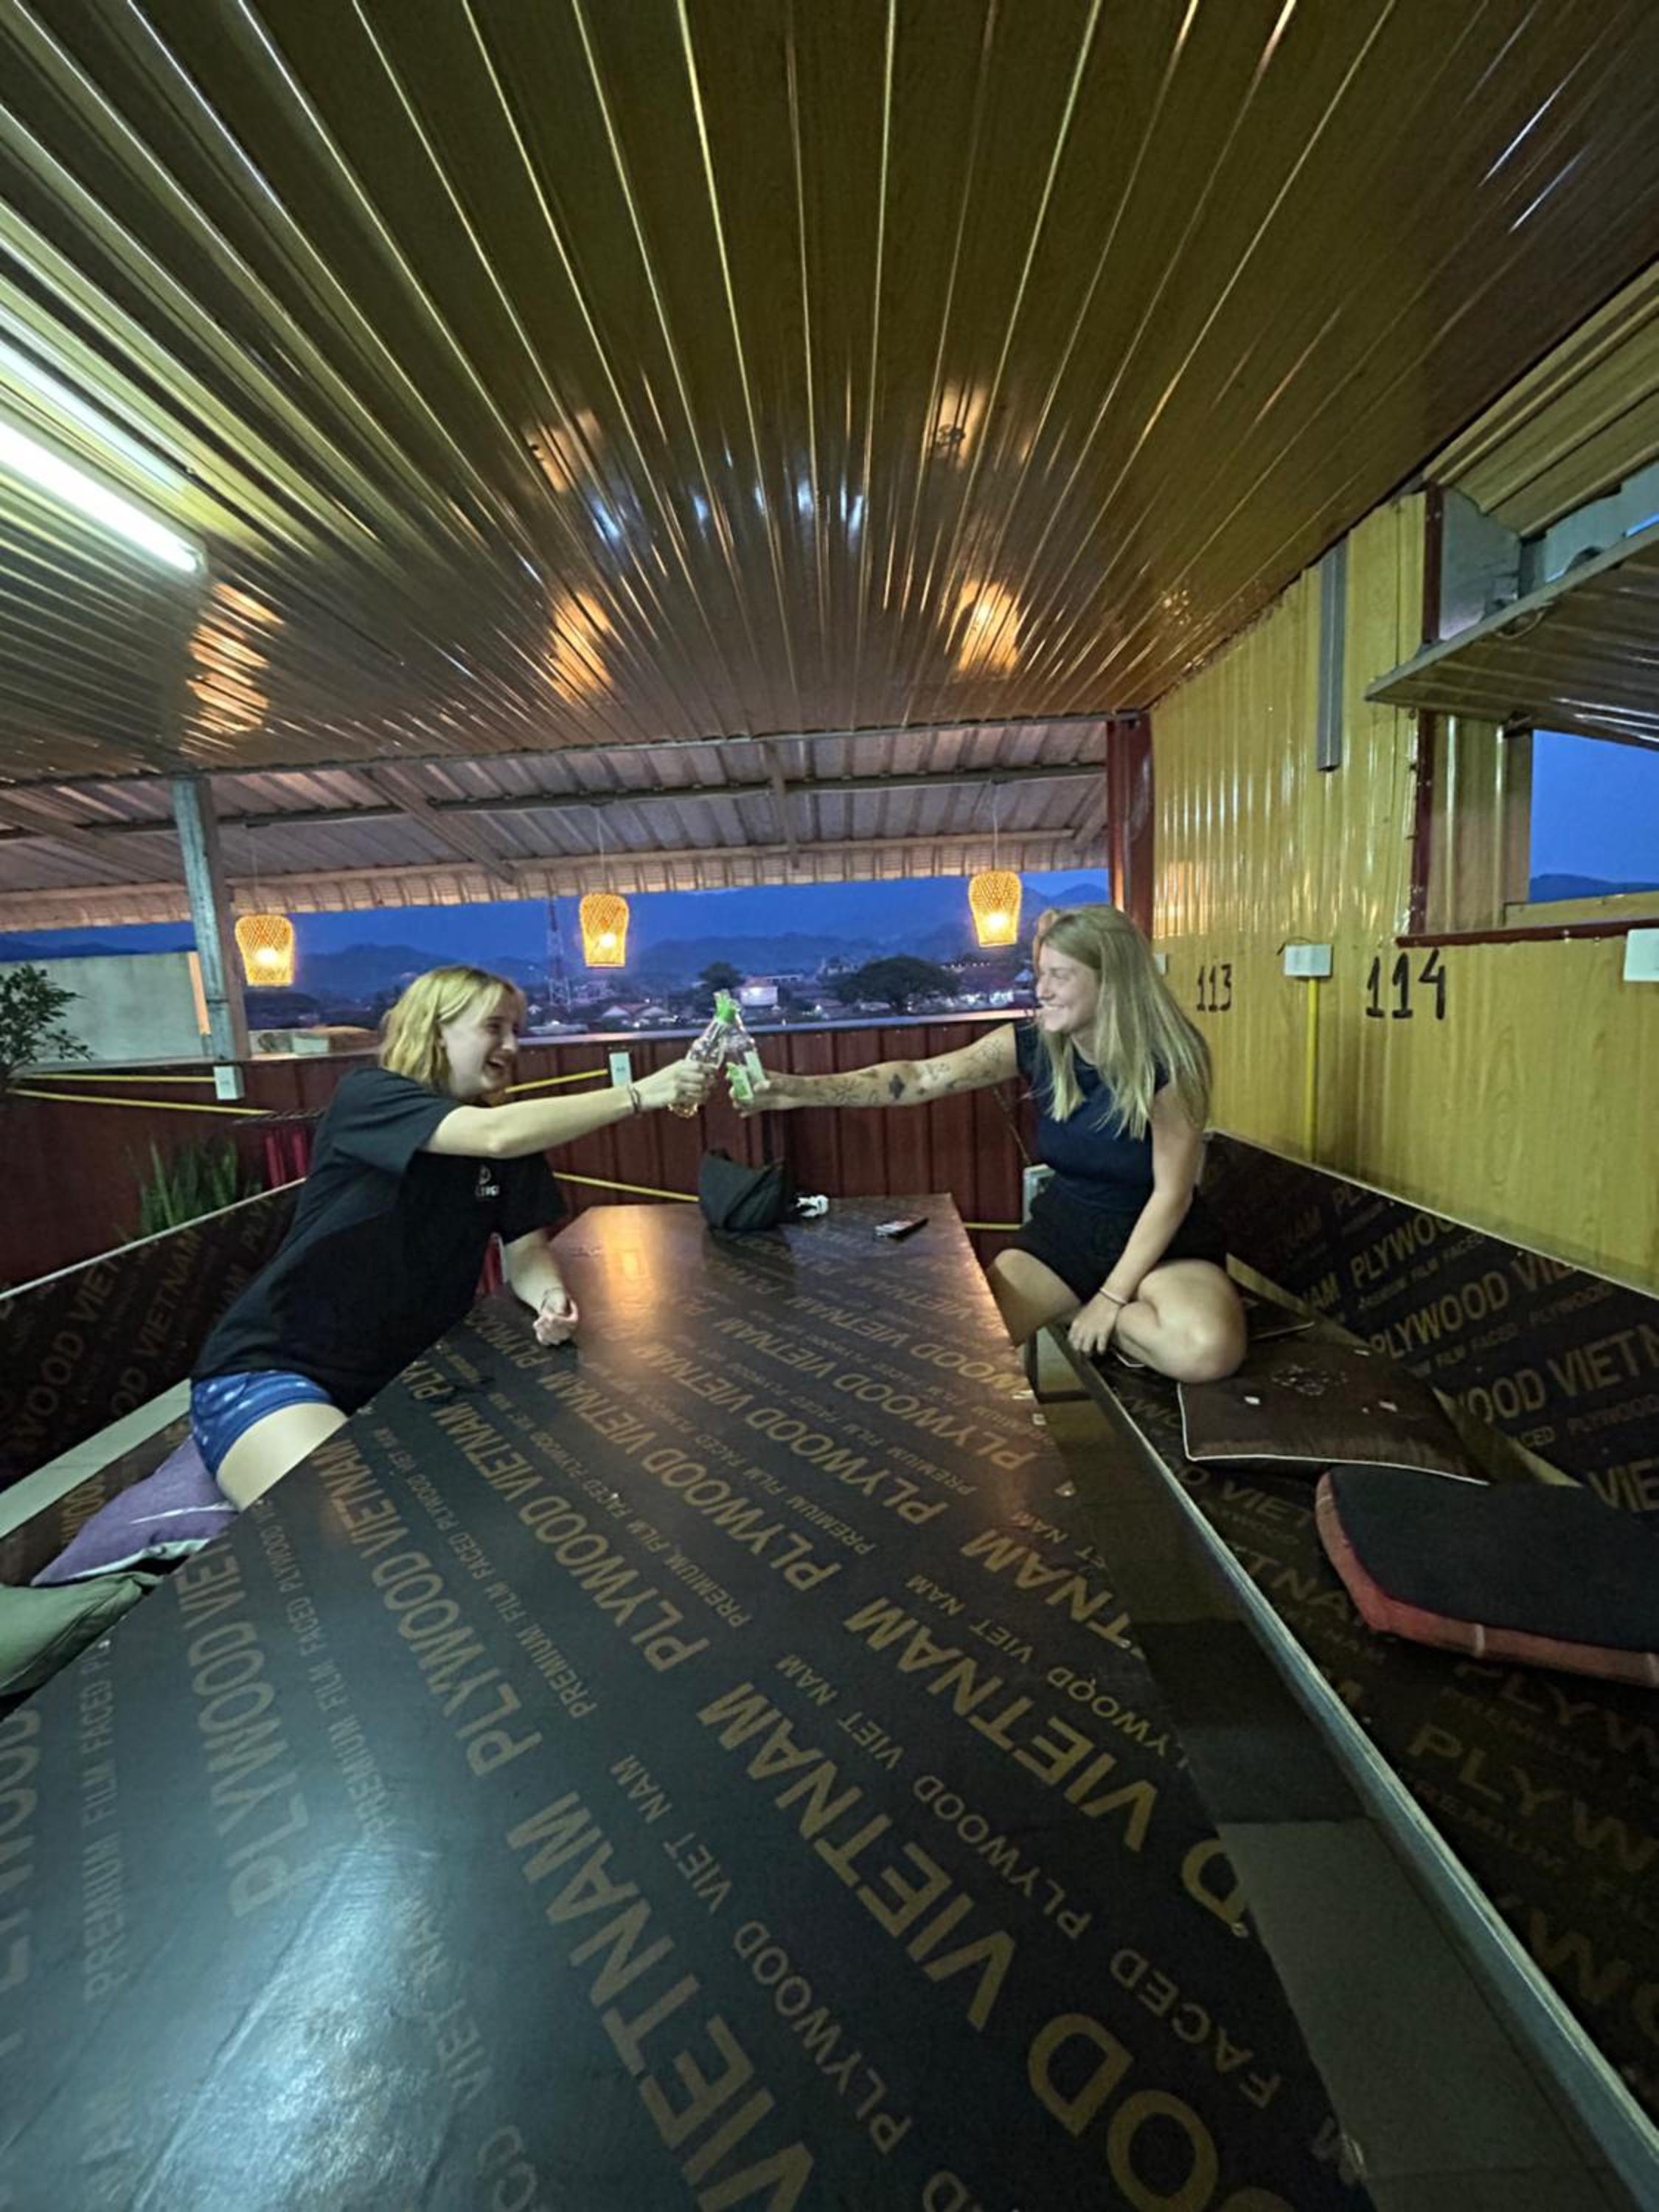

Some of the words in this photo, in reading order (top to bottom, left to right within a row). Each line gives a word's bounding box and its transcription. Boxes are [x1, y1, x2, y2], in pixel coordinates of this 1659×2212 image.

[1197, 964, 1231, 1012] 113
[1366, 948, 1447, 1020] 114
[713, 1317, 838, 1379] VIETNAM
[1369, 1271, 1511, 1361] PLYWOOD
[537, 1369, 657, 1455] VIETNAM
[832, 1373, 1038, 1470] PLYWOOD
[1458, 1368, 1546, 1425] OOD
[430, 1401, 544, 1503] VIETNAM
[743, 1466, 787, 1496] FILM
[745, 1407, 949, 1524] PLYWOOD
[886, 1446, 978, 1495] PREMIUM
[309, 1437, 409, 1559] VIETNAM
[627, 1519, 671, 1554] FILM
[641, 1448, 842, 1592] PLYWOOD
[786, 1495, 877, 1556] PREMIUM
[447, 1533, 496, 1580] FACED
[518, 1495, 711, 1672] PLYWOOD
[664, 1548, 753, 1629] PREMIUM
[905, 1573, 967, 1616] NAM
[285, 1598, 328, 1657] FACED
[484, 1581, 526, 1623] FILM
[967, 1618, 1034, 1664] VIET
[308, 1659, 349, 1711] FILM
[372, 1551, 543, 1776] PLYWOOD
[517, 1623, 598, 1719] PREMIUM
[776, 1652, 838, 1707] NAM
[78, 1680, 114, 1756] FACED
[837, 1711, 905, 1769] VIET
[843, 1596, 1158, 1853] VIETNAM
[1047, 1666, 1190, 1770] YWOOD
[81, 1758, 118, 1829] FILM
[187, 1620, 319, 1919] PLYWOOD
[329, 1714, 396, 1834] PREMIUM
[609, 1753, 672, 1825] NAM
[663, 1832, 732, 1915] VIET
[697, 1682, 1016, 2033] VIETNAM
[913, 1774, 1092, 1940] PLYWOOD
[83, 1832, 128, 2003] PREMIUM
[507, 1791, 815, 2212] VIETNAM
[733, 1920, 913, 2157] PLYWOOD
[1110, 1948, 1281, 2108] FACED
